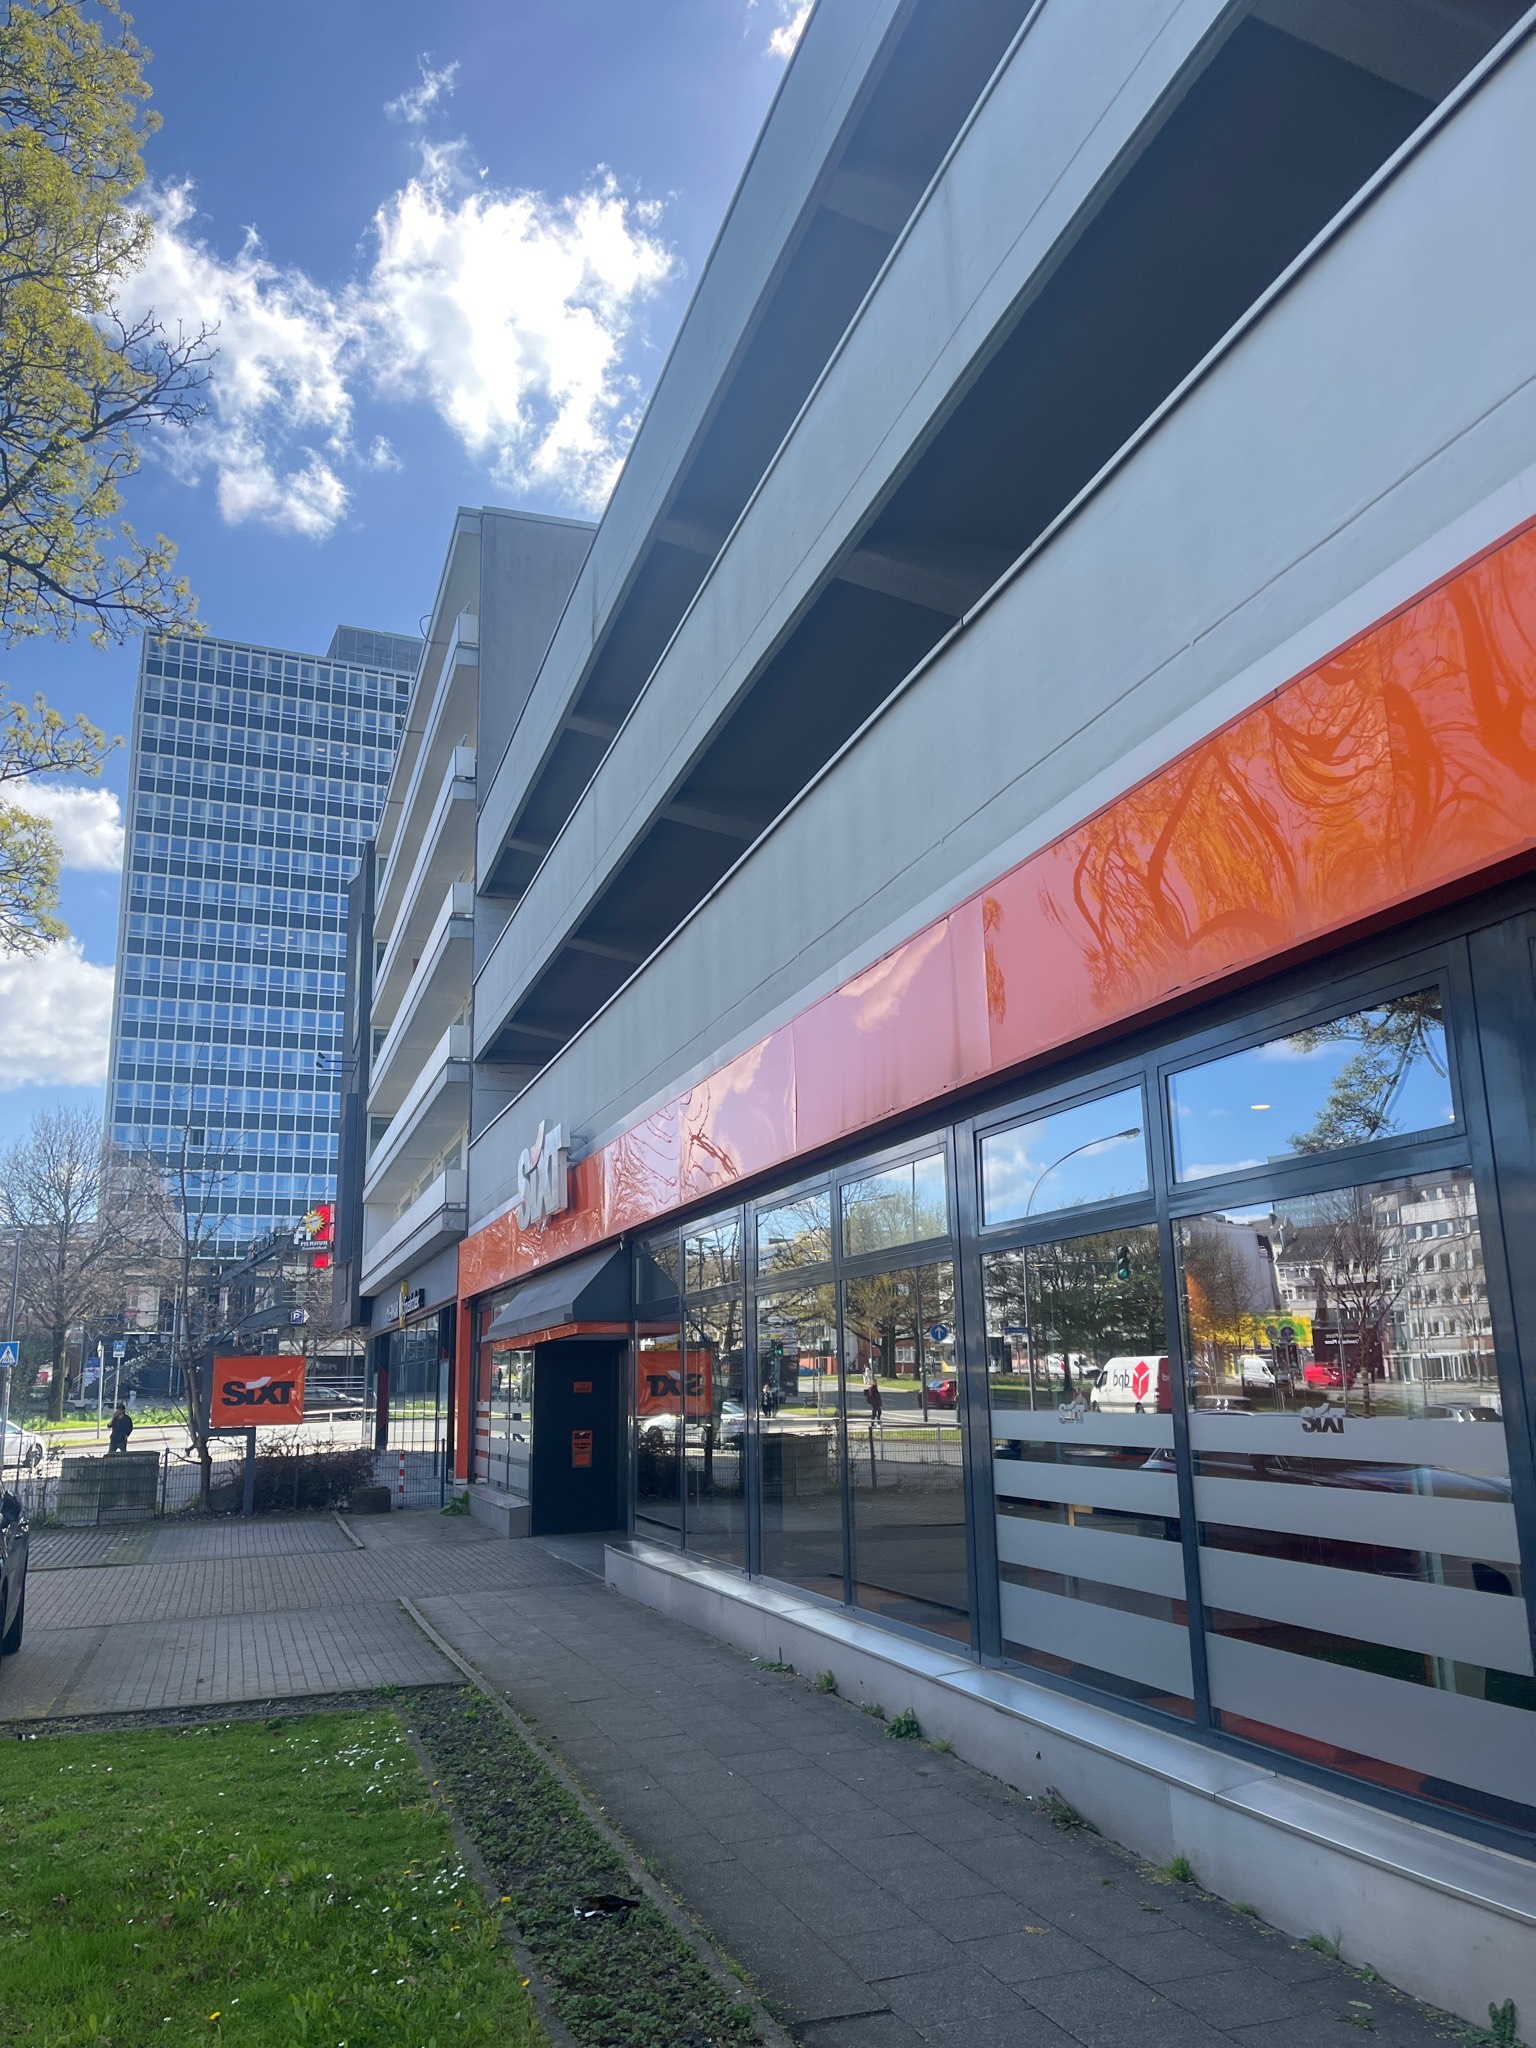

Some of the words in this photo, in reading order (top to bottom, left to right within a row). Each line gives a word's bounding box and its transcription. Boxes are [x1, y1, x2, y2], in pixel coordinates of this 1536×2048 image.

[517, 1119, 570, 1231] SIXT
[221, 1376, 295, 1406] SIXT
[1300, 1403, 1346, 1433] SIXT
